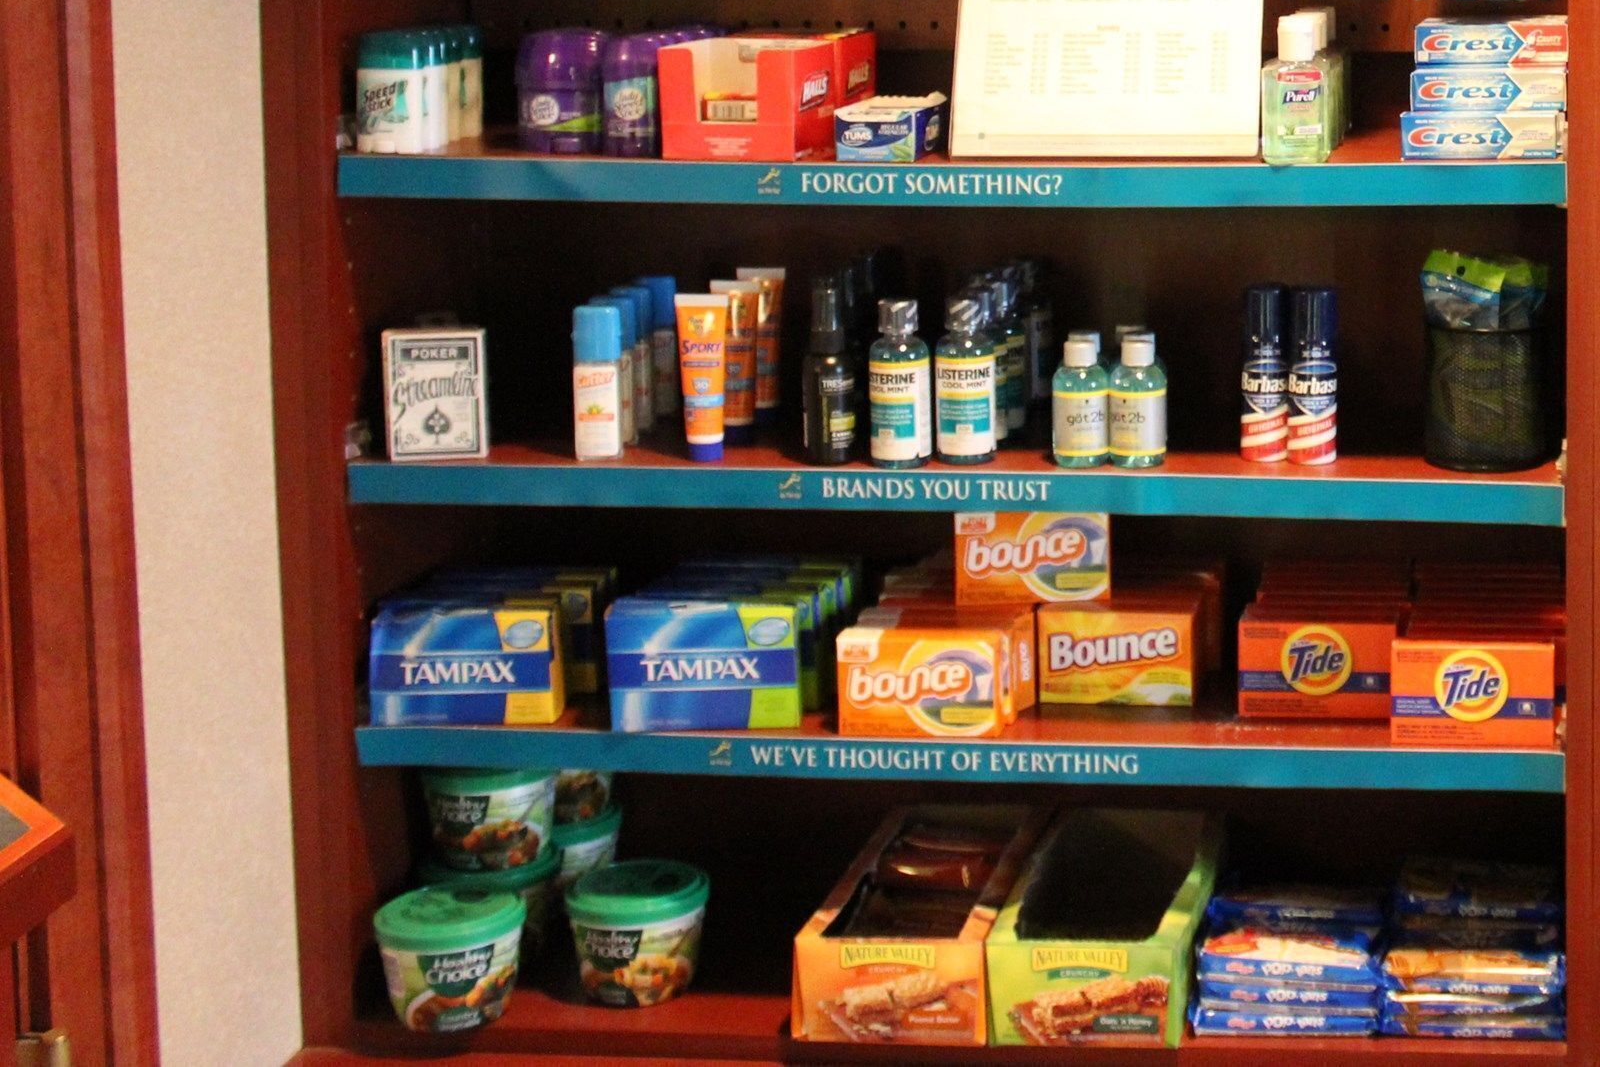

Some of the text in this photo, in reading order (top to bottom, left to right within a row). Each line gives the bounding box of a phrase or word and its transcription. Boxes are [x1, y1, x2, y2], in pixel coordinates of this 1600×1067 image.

[1422, 34, 1516, 53] Crest
[1285, 90, 1315, 103] Purell
[1419, 81, 1514, 101] Crest
[844, 130, 872, 141] TUMS
[1408, 127, 1505, 147] Crest
[801, 172, 1063, 196] FORGOT SOMETHING?
[411, 347, 458, 360] POKER
[682, 340, 721, 355] SPORT
[869, 371, 916, 385] STERINE
[937, 367, 991, 380] LISTERINE
[1241, 372, 1286, 394] Barbas
[1288, 372, 1337, 396] Barbaso
[942, 380, 988, 389] COOL MINT
[823, 478, 1052, 501] BRANDS YOU TRUST
[966, 529, 1086, 573] bounce
[1049, 628, 1179, 670] Bounce
[400, 660, 515, 685] TAMPAX
[640, 657, 760, 682] TAMPAX
[1289, 644, 1345, 682] Tide
[849, 663, 966, 702] bounce
[1443, 669, 1500, 710] Tide
[750, 744, 1140, 775] WE'VE THOUGHT OF EVERYTHING
[435, 950, 492, 971] Healthy
[844, 945, 933, 963] NATURE VALLEY
[1036, 949, 1126, 967] NATURE VALLEY
[426, 964, 488, 985] Choice
[910, 1015, 935, 1025] Peanut
